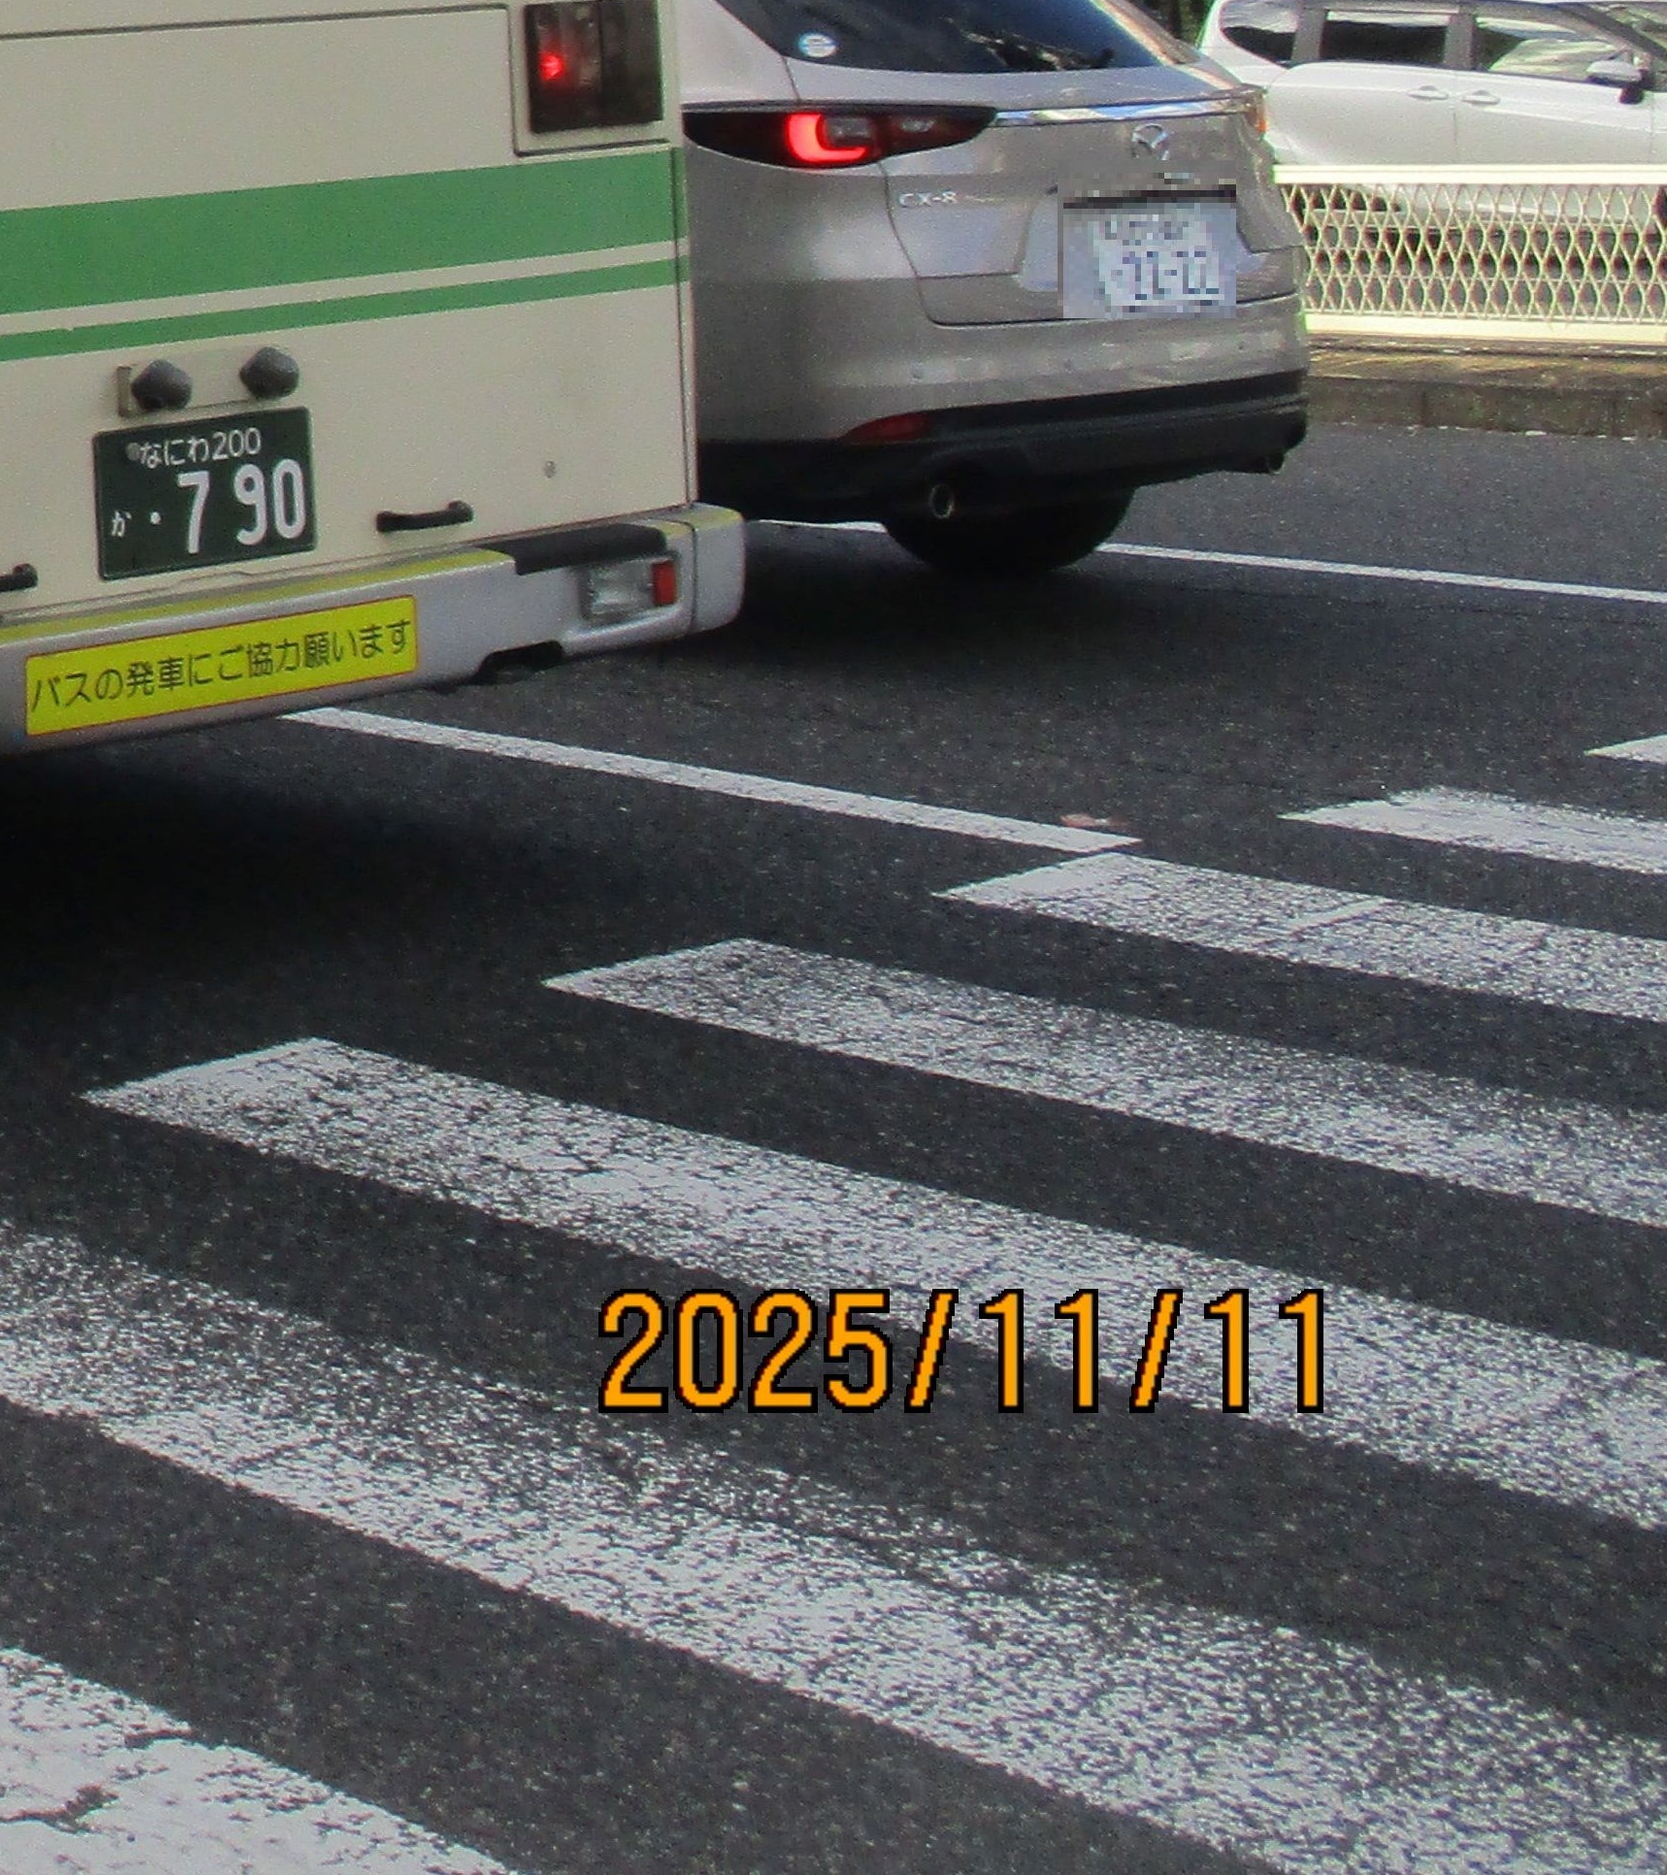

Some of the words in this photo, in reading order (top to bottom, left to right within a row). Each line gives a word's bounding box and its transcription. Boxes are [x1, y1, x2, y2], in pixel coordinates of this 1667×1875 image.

[30, 618, 412, 711] バスの発車にご協力願います
